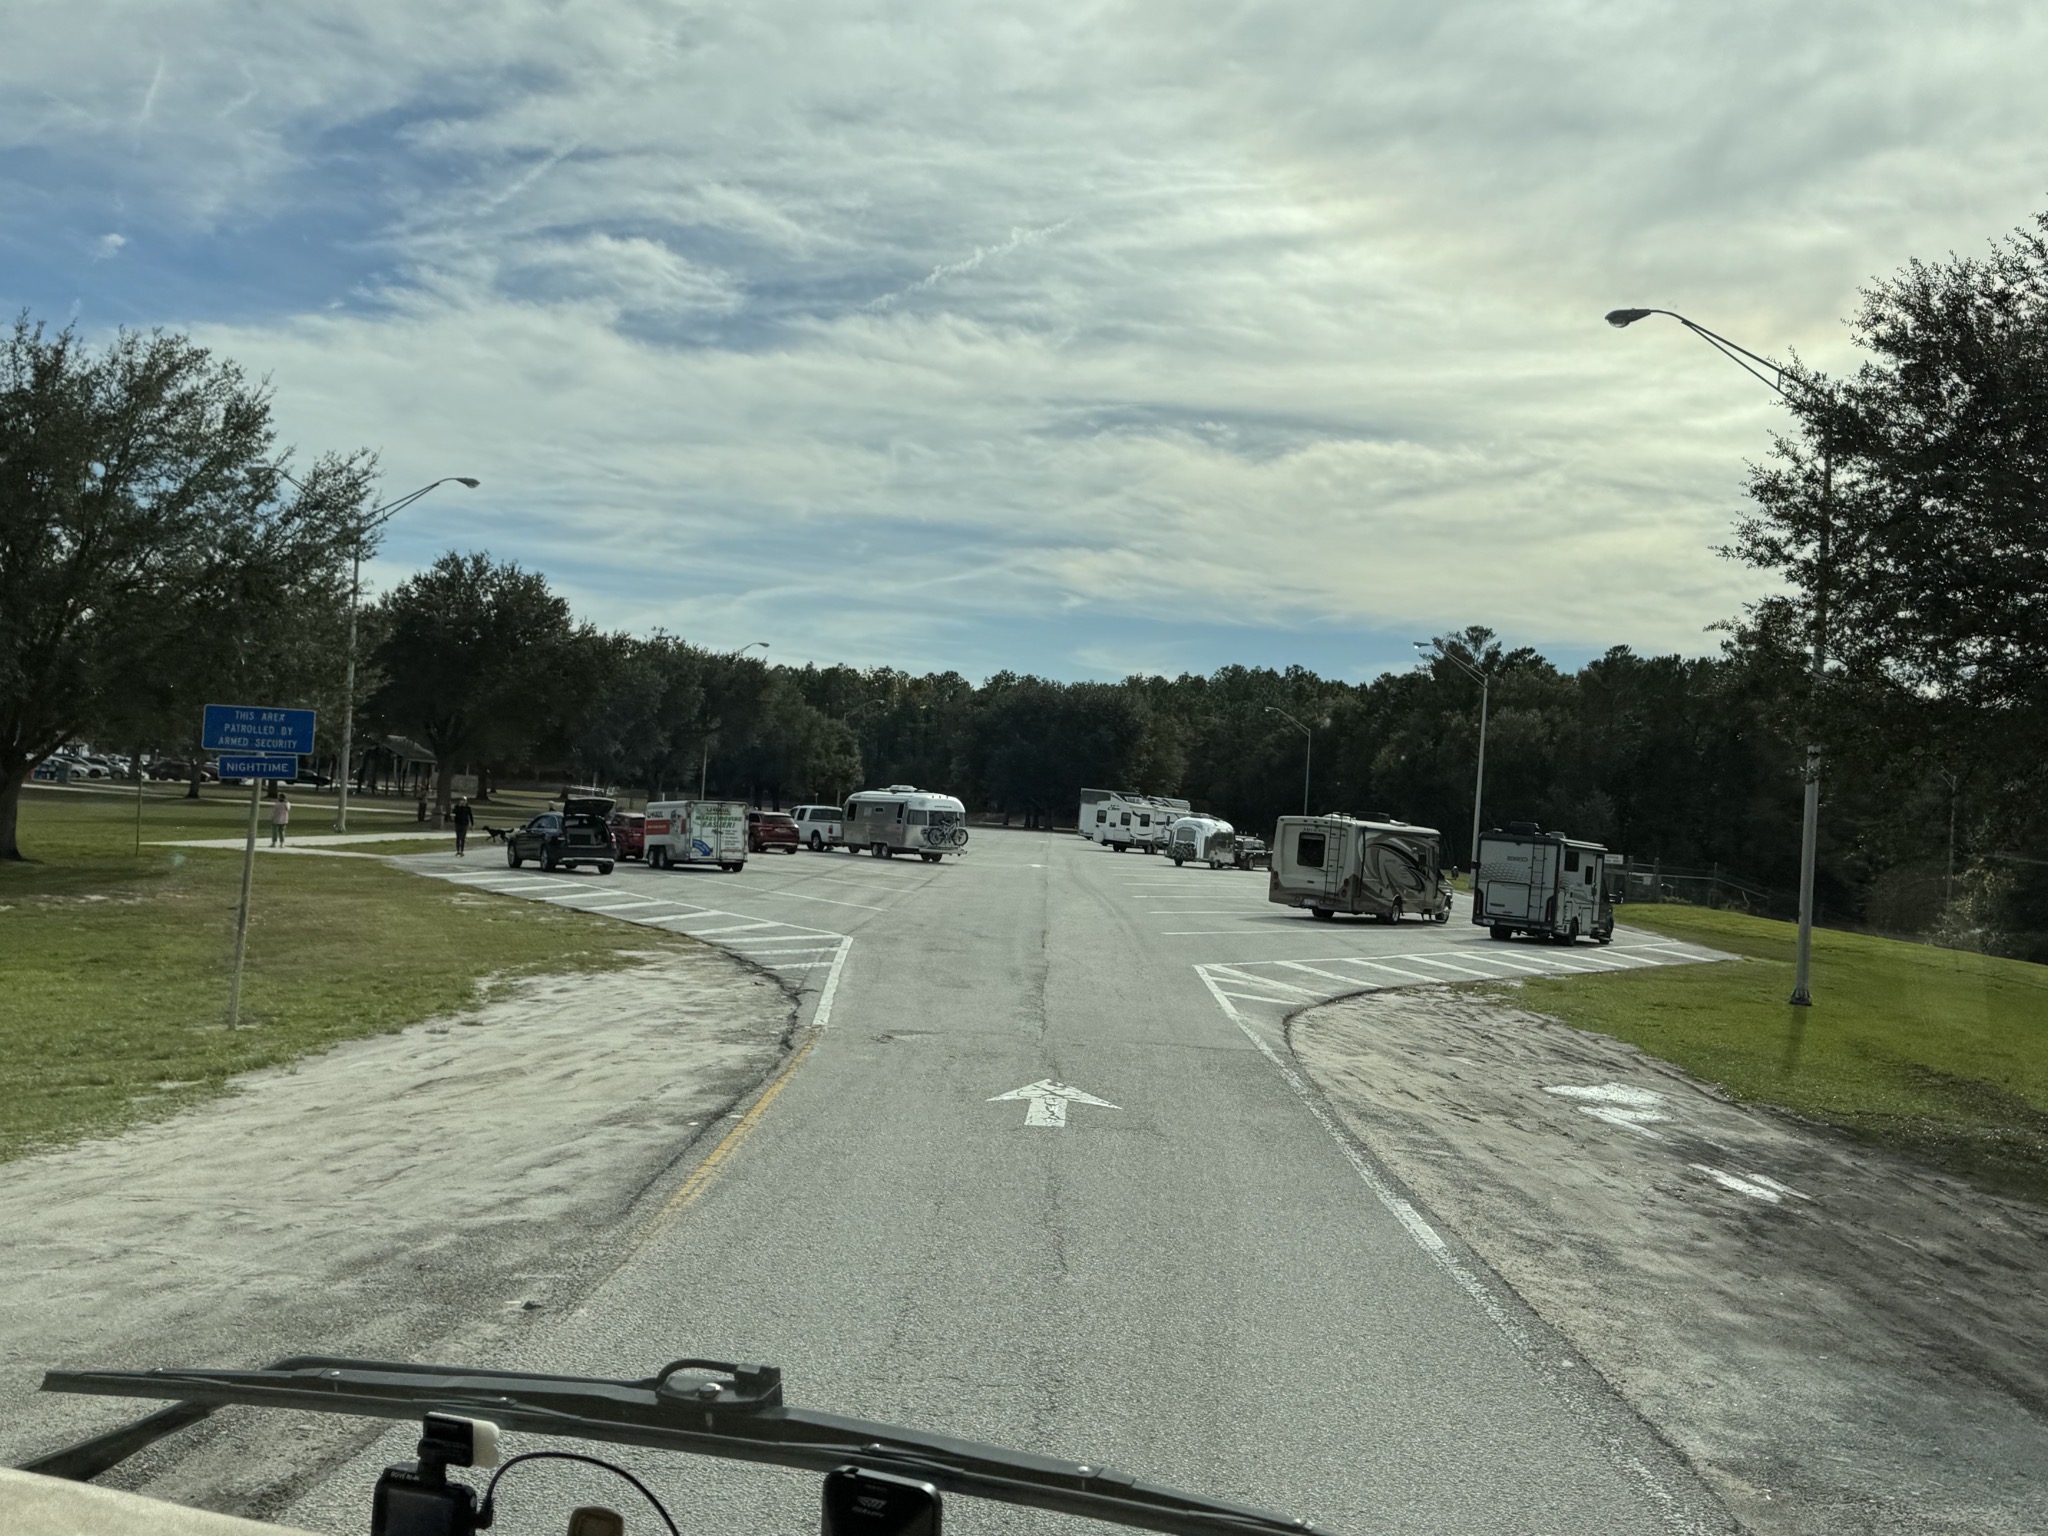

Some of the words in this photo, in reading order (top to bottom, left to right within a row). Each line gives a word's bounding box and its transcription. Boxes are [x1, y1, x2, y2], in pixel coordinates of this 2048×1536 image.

[235, 710, 255, 721] THIS
[261, 712, 286, 722] AREA
[224, 723, 275, 735] PATROLLED
[281, 726, 293, 736] BY
[218, 736, 249, 746] ARMED
[255, 738, 297, 748] SECURITY
[226, 762, 289, 773] NIGHTTIME
